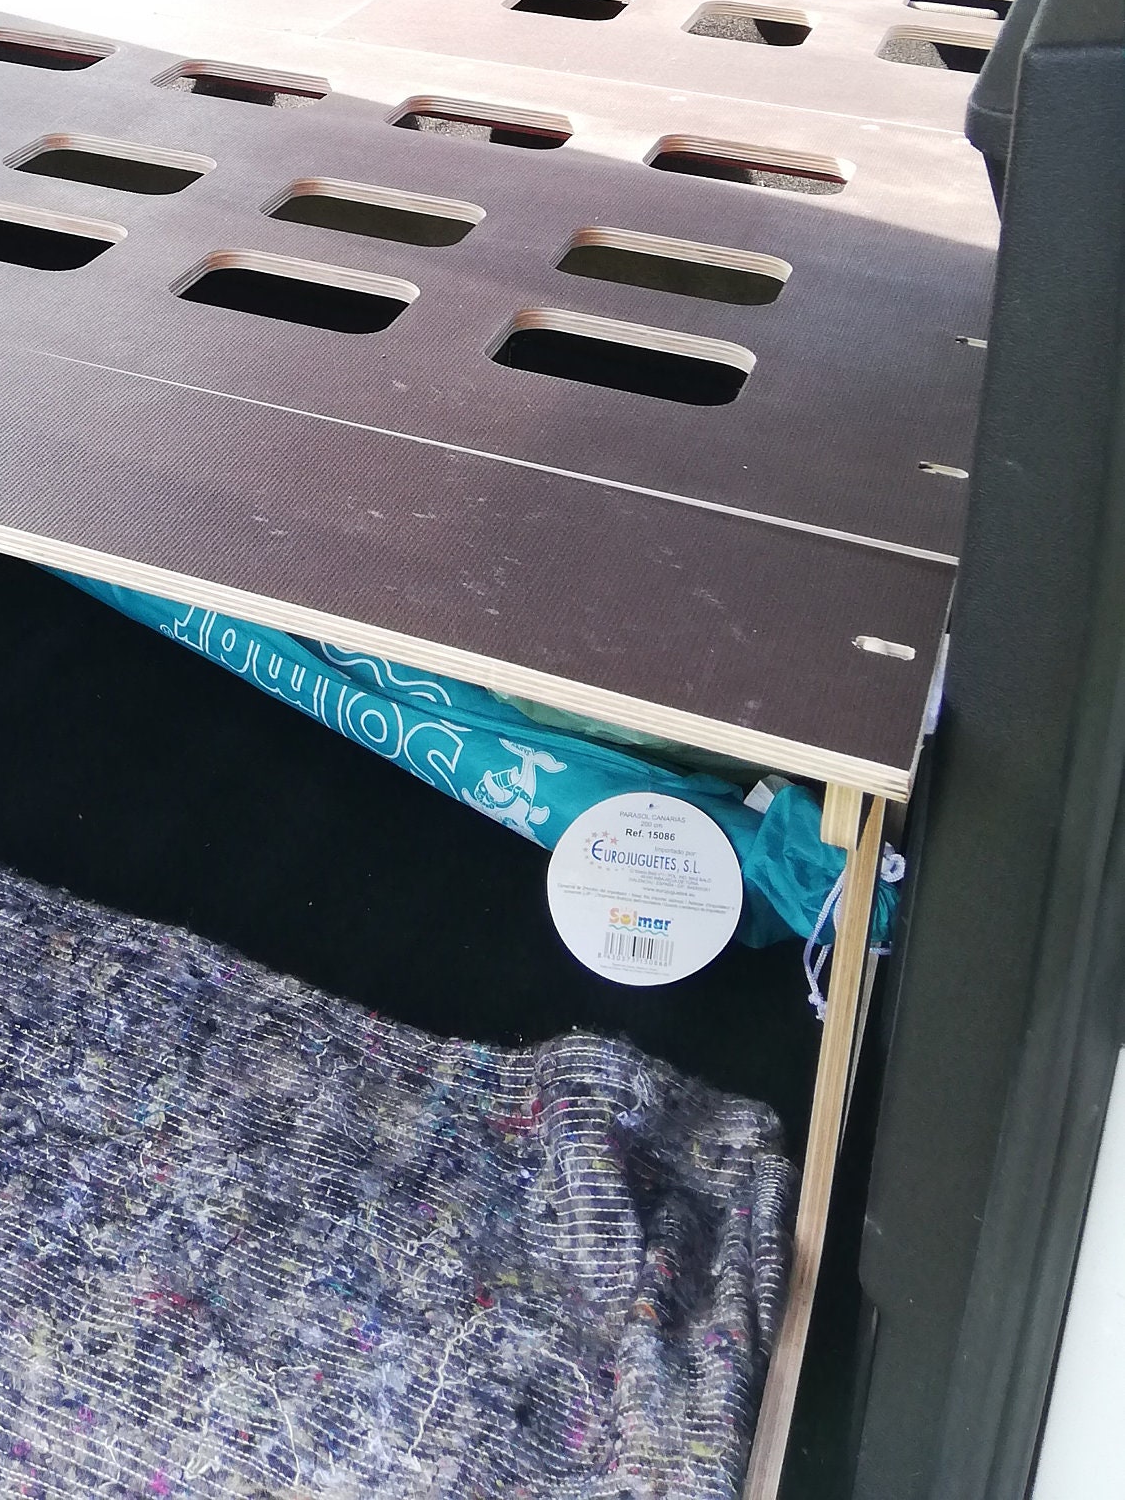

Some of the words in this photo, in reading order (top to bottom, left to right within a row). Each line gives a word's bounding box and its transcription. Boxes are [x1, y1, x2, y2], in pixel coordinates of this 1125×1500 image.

[619, 811, 650, 821] PARASOL
[651, 814, 686, 824] CANARIAS
[625, 827, 644, 838] Ref.
[648, 831, 676, 842] 15086
[683, 859, 701, 875] S.L.
[609, 907, 672, 931] Solmar
